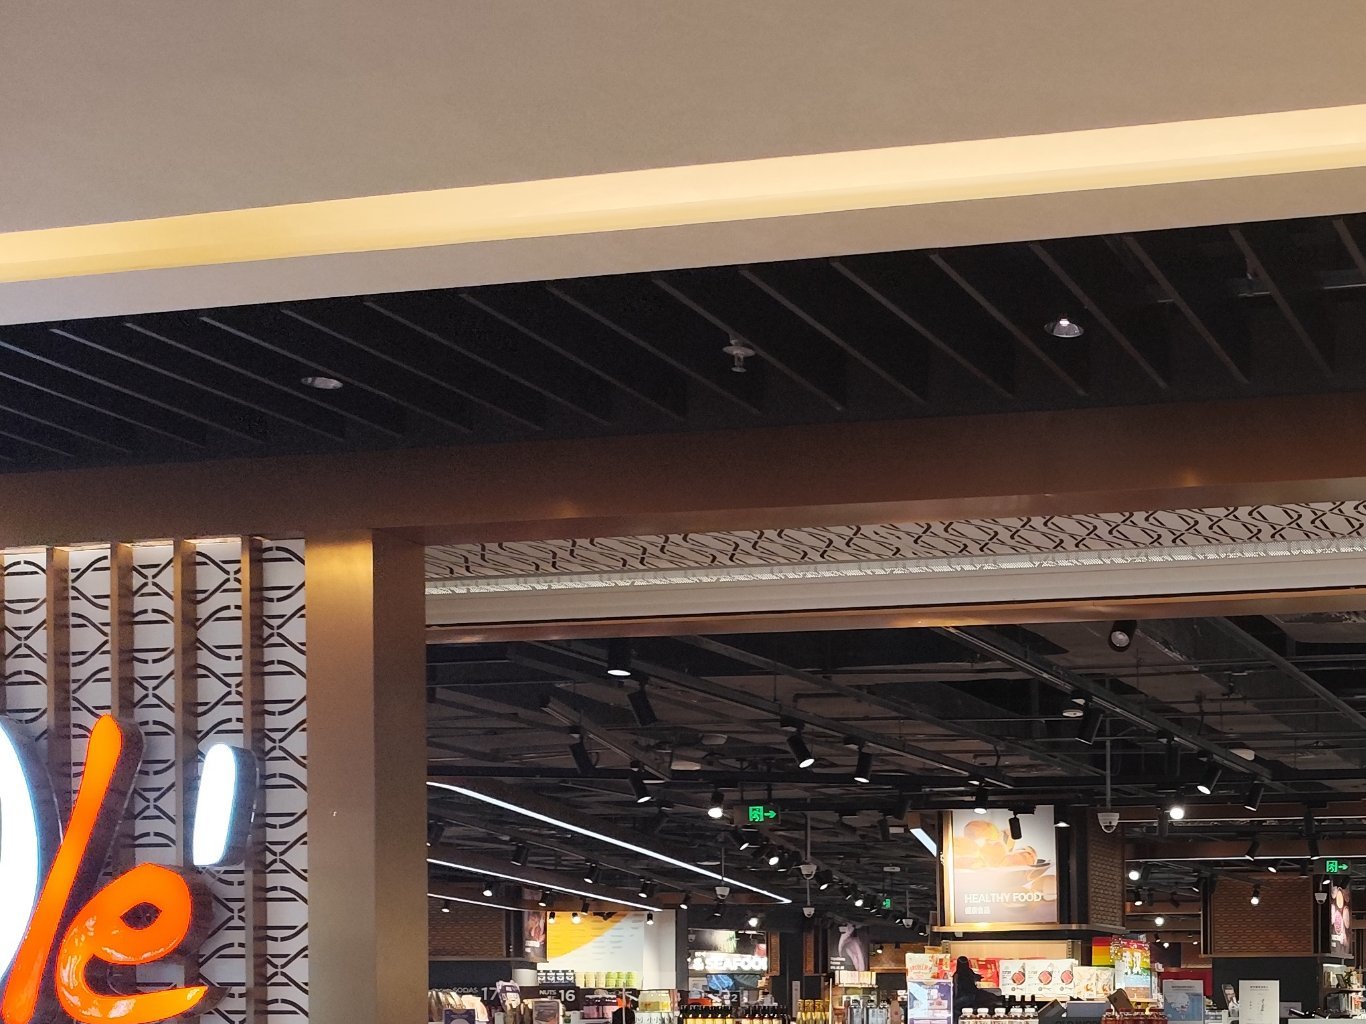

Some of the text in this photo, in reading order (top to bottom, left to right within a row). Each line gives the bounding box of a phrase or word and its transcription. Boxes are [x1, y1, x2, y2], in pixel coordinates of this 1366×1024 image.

[964, 892, 1042, 904] HEALTHY FOOD
[481, 987, 498, 1000] 17
[559, 990, 576, 1002] 16
